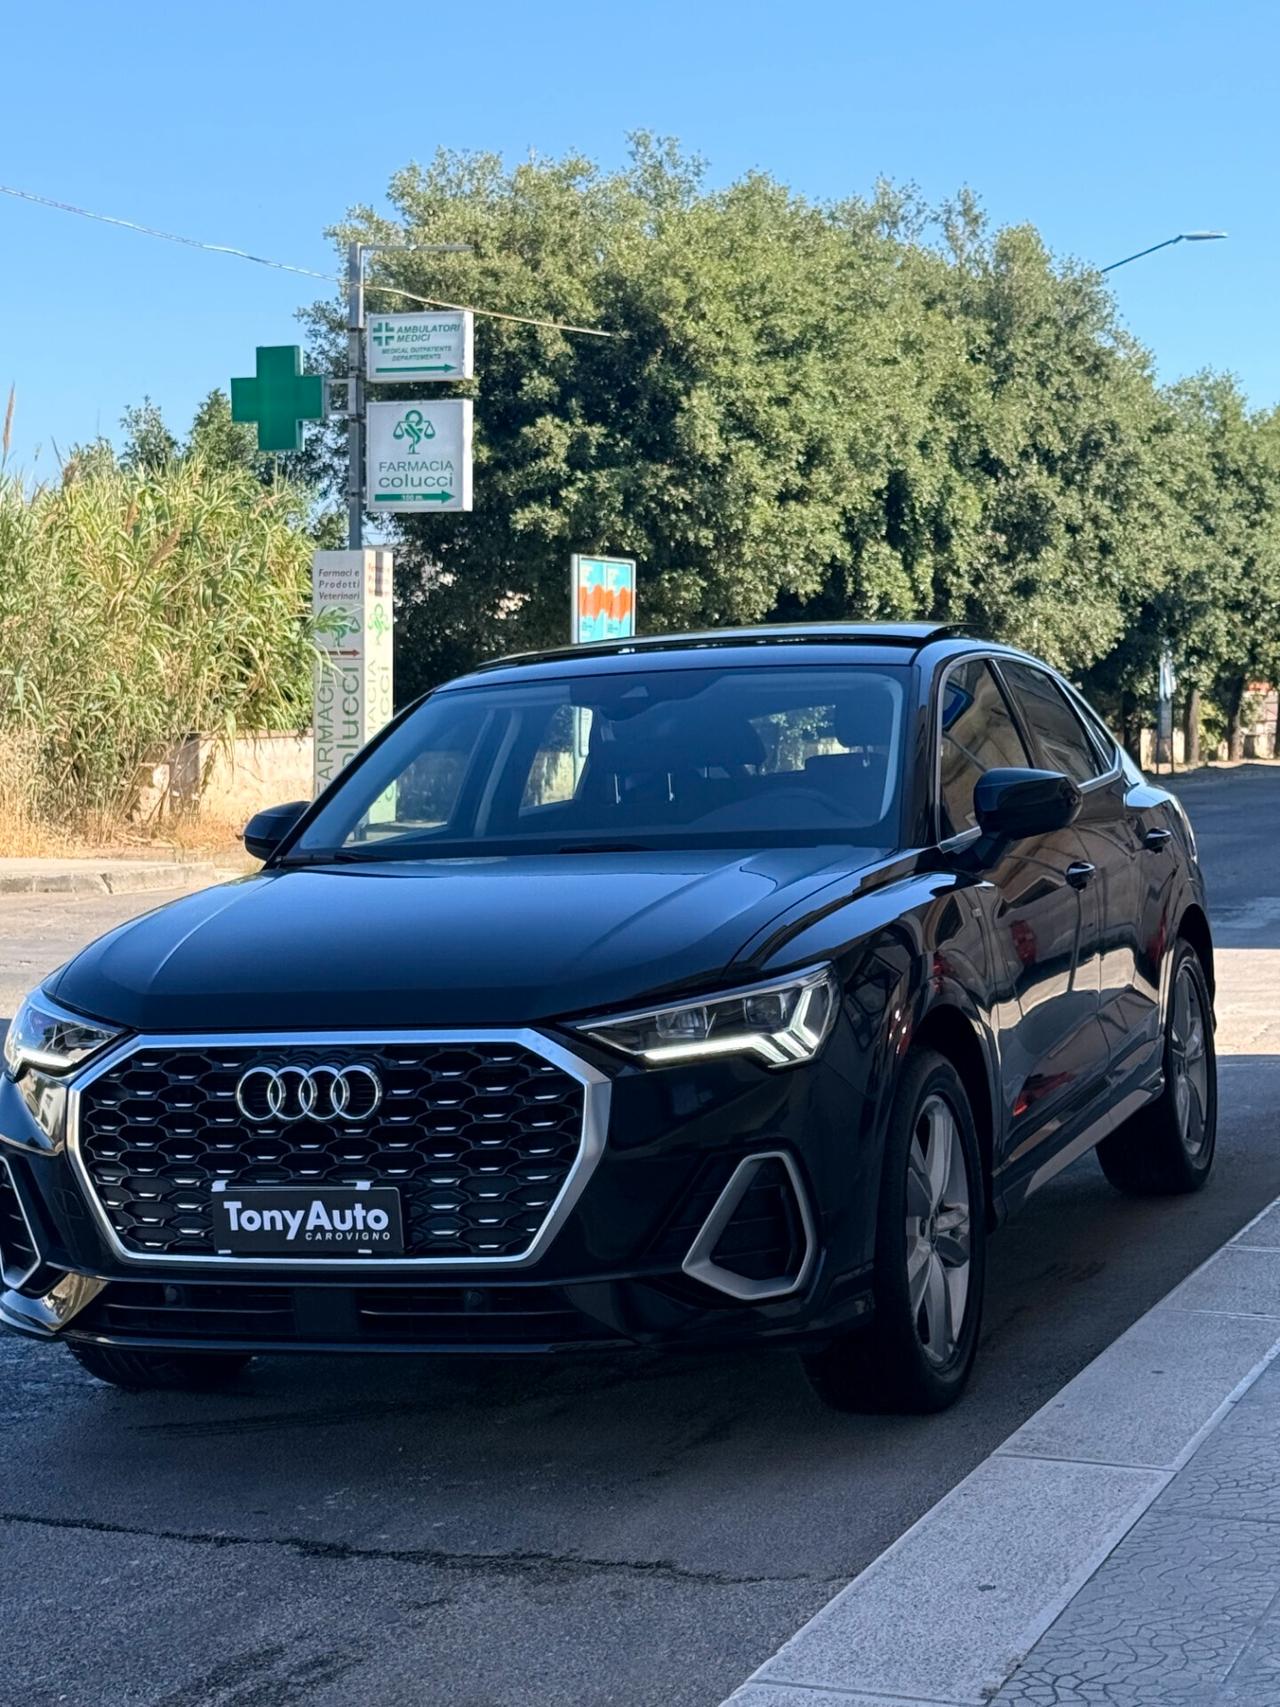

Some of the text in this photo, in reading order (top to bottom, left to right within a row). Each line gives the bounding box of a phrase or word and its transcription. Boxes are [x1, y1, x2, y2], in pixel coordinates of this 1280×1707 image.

[397, 323, 460, 334] AMBULATORI
[397, 334, 431, 343] MEDICI
[379, 460, 454, 472] FARMACIA
[378, 473, 453, 488] colucci
[318, 568, 352, 577] Farmaci
[318, 579, 360, 589] Prodotti
[319, 591, 360, 600] Veterinari
[336, 667, 359, 768] lucci
[305, 1232, 391, 1241] CAROVIGNO
